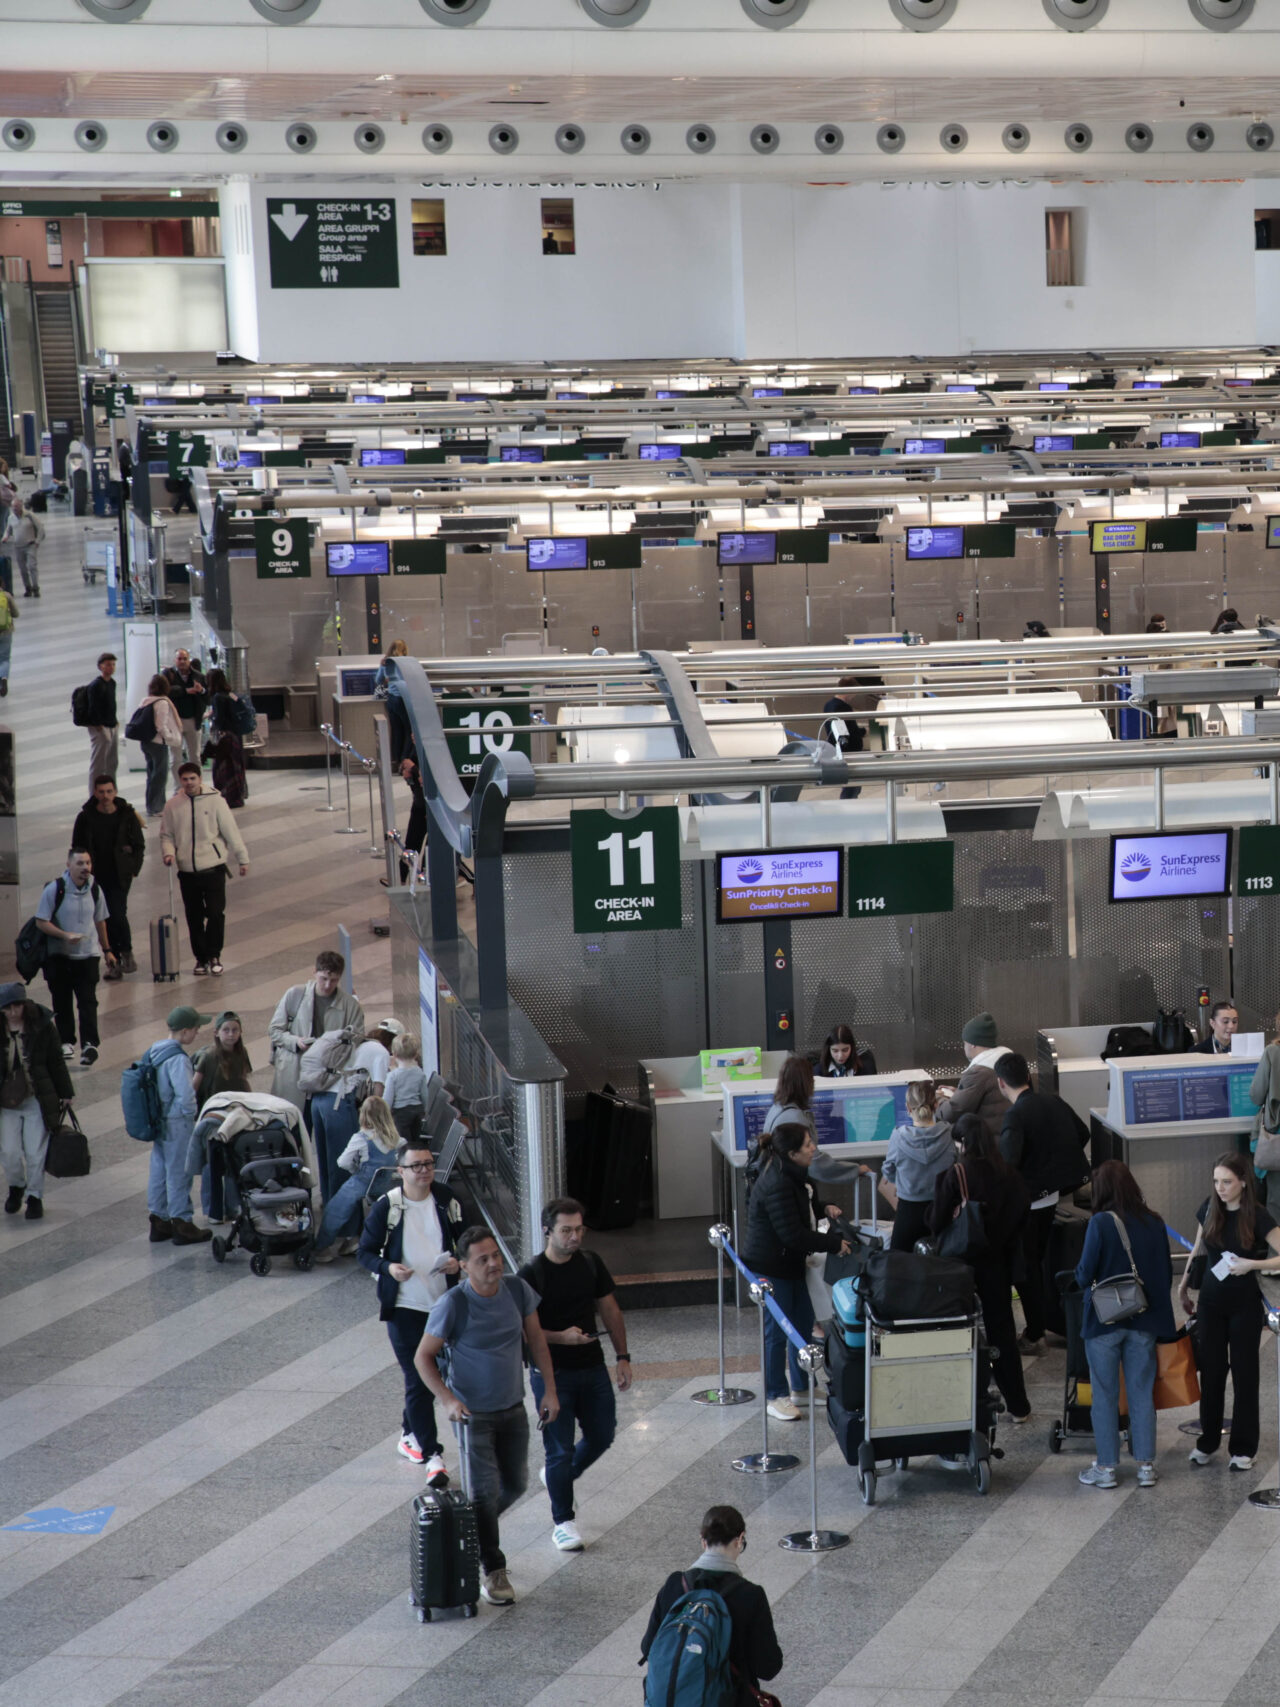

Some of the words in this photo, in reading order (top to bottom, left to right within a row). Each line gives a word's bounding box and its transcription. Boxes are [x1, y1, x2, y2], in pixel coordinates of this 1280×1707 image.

[317, 203, 361, 212] CHECK-IN
[363, 203, 391, 221] 1-3
[317, 212, 343, 221] AREA
[318, 224, 344, 233] AREA
[345, 224, 380, 233] GRUPPI
[318, 234, 346, 243] Group
[319, 245, 343, 253] SALA
[319, 254, 362, 262] RESPIGHI
[114, 392, 125, 408] 5
[178, 442, 194, 463] 7
[271, 528, 293, 557] 9
[782, 553, 795, 561] 912
[969, 548, 980, 556] 911
[268, 560, 299, 568] CHECK-IN
[397, 565, 410, 573] 914
[593, 559, 606, 567] 913
[459, 710, 515, 755] 10
[598, 831, 655, 886] 11
[1160, 853, 1221, 867] SunExpress
[771, 859, 823, 872] SunExpress
[1160, 865, 1197, 877] Airlines
[770, 869, 803, 879] Airlines
[1245, 876, 1273, 889] 1113
[726, 887, 785, 901] SunPriority
[787, 885, 833, 897] Check-In
[594, 896, 655, 910] CHECK-IN
[856, 897, 886, 911] 1114
[607, 910, 642, 922] AREA
